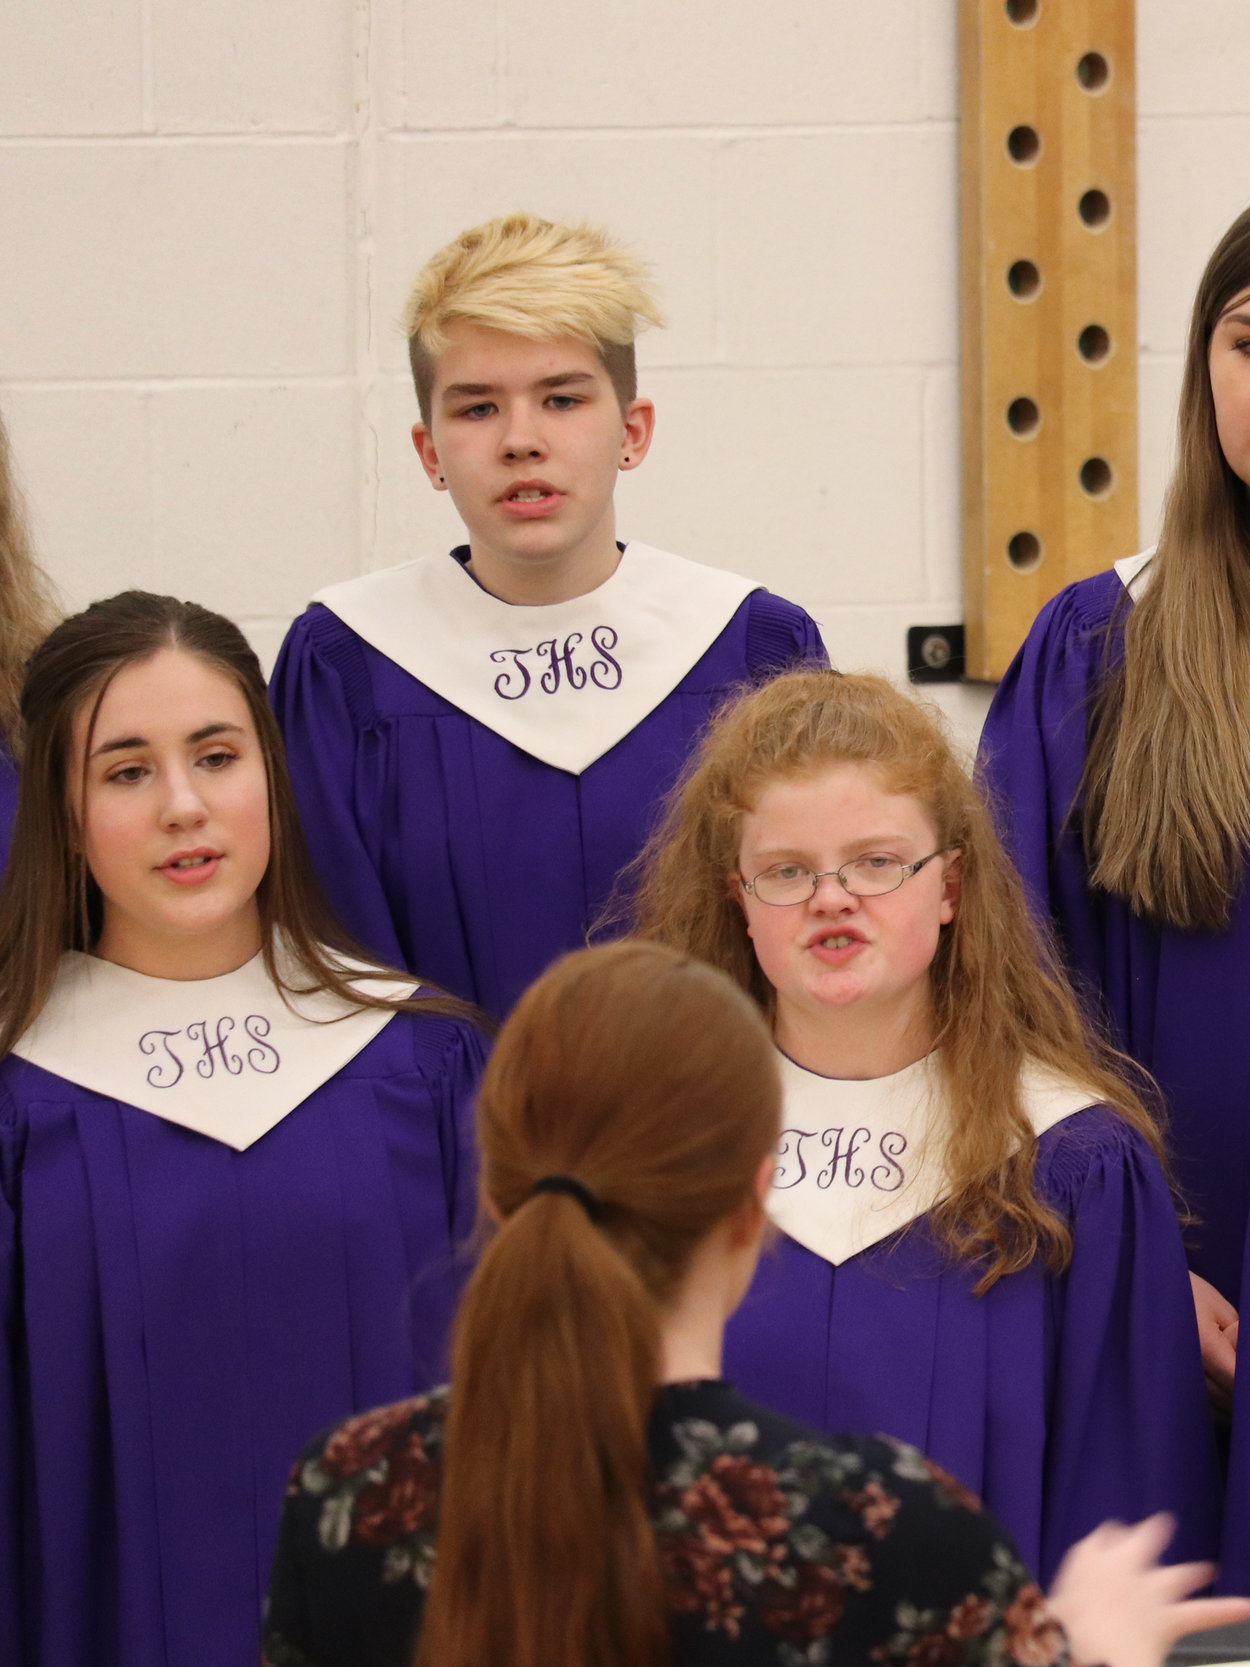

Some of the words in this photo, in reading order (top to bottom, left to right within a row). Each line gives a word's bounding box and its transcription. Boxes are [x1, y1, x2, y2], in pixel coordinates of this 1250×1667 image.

[489, 625, 623, 701] THS
[138, 1014, 281, 1089] THS
[771, 1127, 908, 1193] THS
